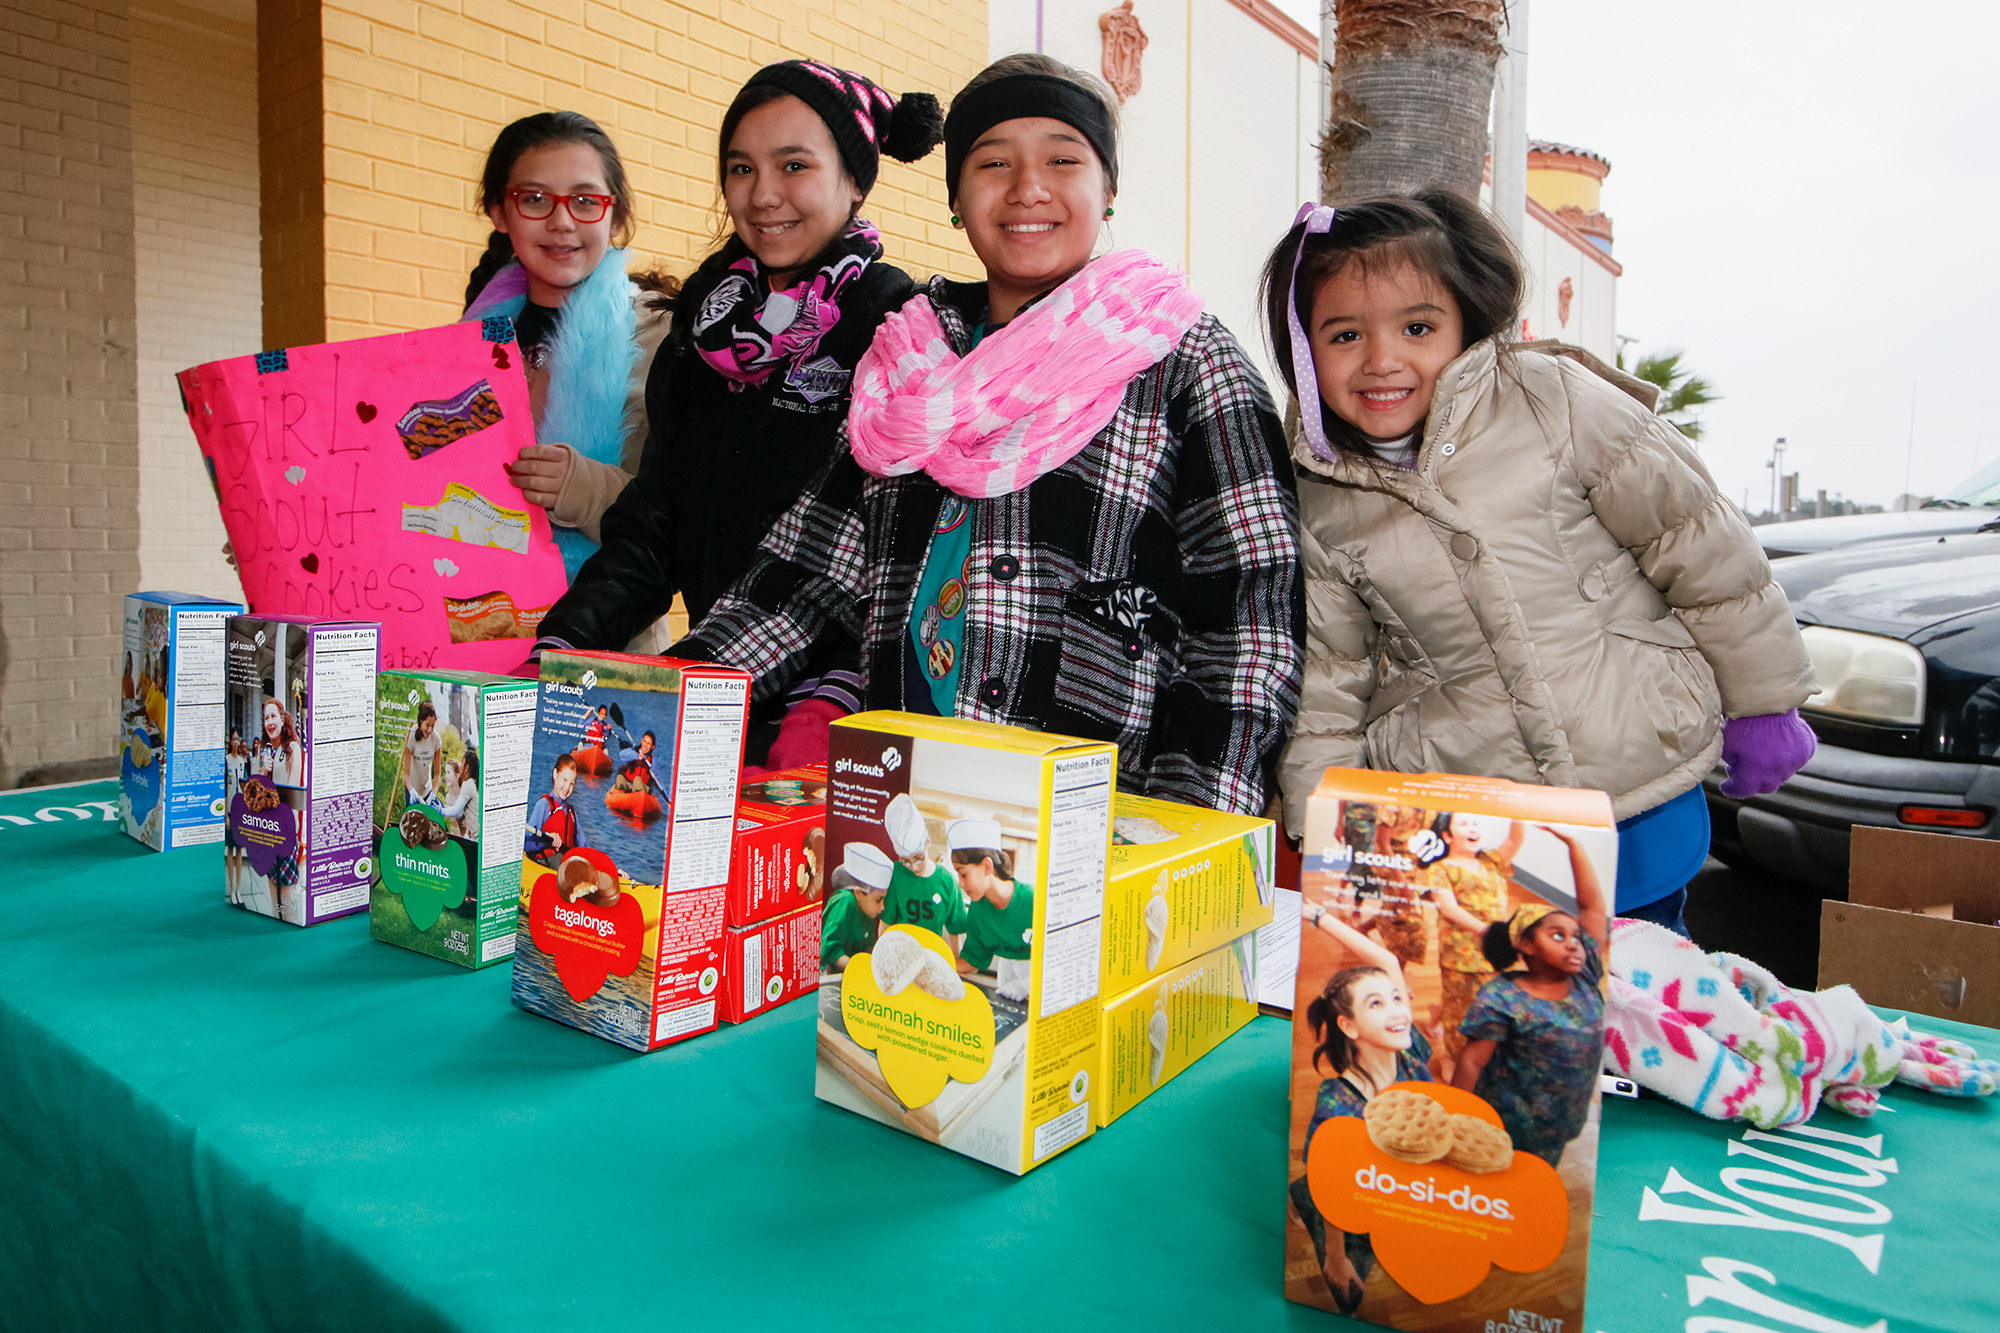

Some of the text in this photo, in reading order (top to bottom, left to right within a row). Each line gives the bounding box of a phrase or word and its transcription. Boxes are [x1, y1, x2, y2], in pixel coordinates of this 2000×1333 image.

[229, 641, 257, 652] girl scouts
[545, 680, 584, 696] girl scouts
[687, 681, 746, 690] Nutrition Facts
[380, 698, 410, 712] girl scouts
[486, 693, 519, 702] Nutrition
[835, 757, 885, 778] girl scouts
[1055, 756, 1110, 773] Nutrition Facts
[131, 771, 149, 788] trefoils
[395, 852, 417, 871] thin
[1321, 843, 1414, 872] girl scouts
[906, 898, 934, 924] gs
[848, 994, 924, 1031] savannah
[866, 1018, 884, 1033] zesty
[884, 1025, 906, 1039] lemon
[906, 1031, 929, 1047] wedge
[929, 1039, 958, 1056] cookies
[958, 1048, 985, 1065] dusted
[876, 1032, 892, 1044] with
[892, 1037, 928, 1056] powdered
[1508, 1307, 1565, 1333] NET WT
